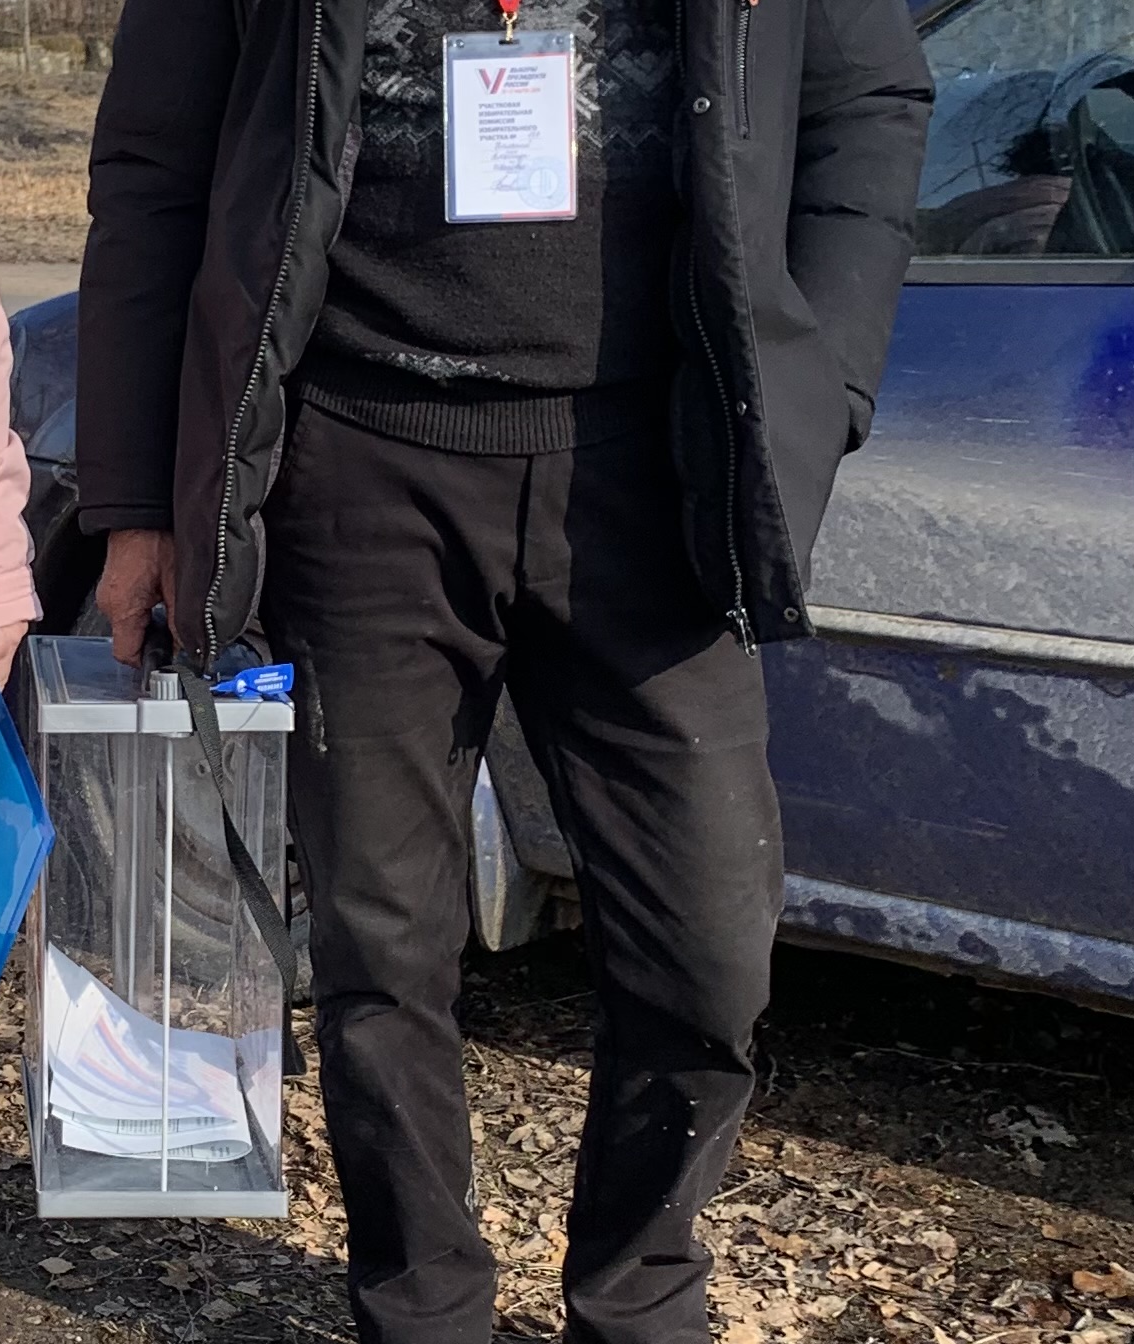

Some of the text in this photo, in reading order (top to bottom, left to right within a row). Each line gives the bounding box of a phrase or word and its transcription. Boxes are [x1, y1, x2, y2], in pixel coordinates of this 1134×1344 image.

[509, 66, 539, 74] ВЫБОРЫ
[506, 72, 547, 81] ПРЕЗИДЕНТА
[478, 102, 521, 110] УЧАСТКОВАЯ
[478, 109, 533, 118] ИЗБИРАТЕЛЬНАЯ
[479, 125, 538, 134] ИЗБИРАТЕЛЬНОГО
[479, 134, 509, 142] УЧАСТКА
